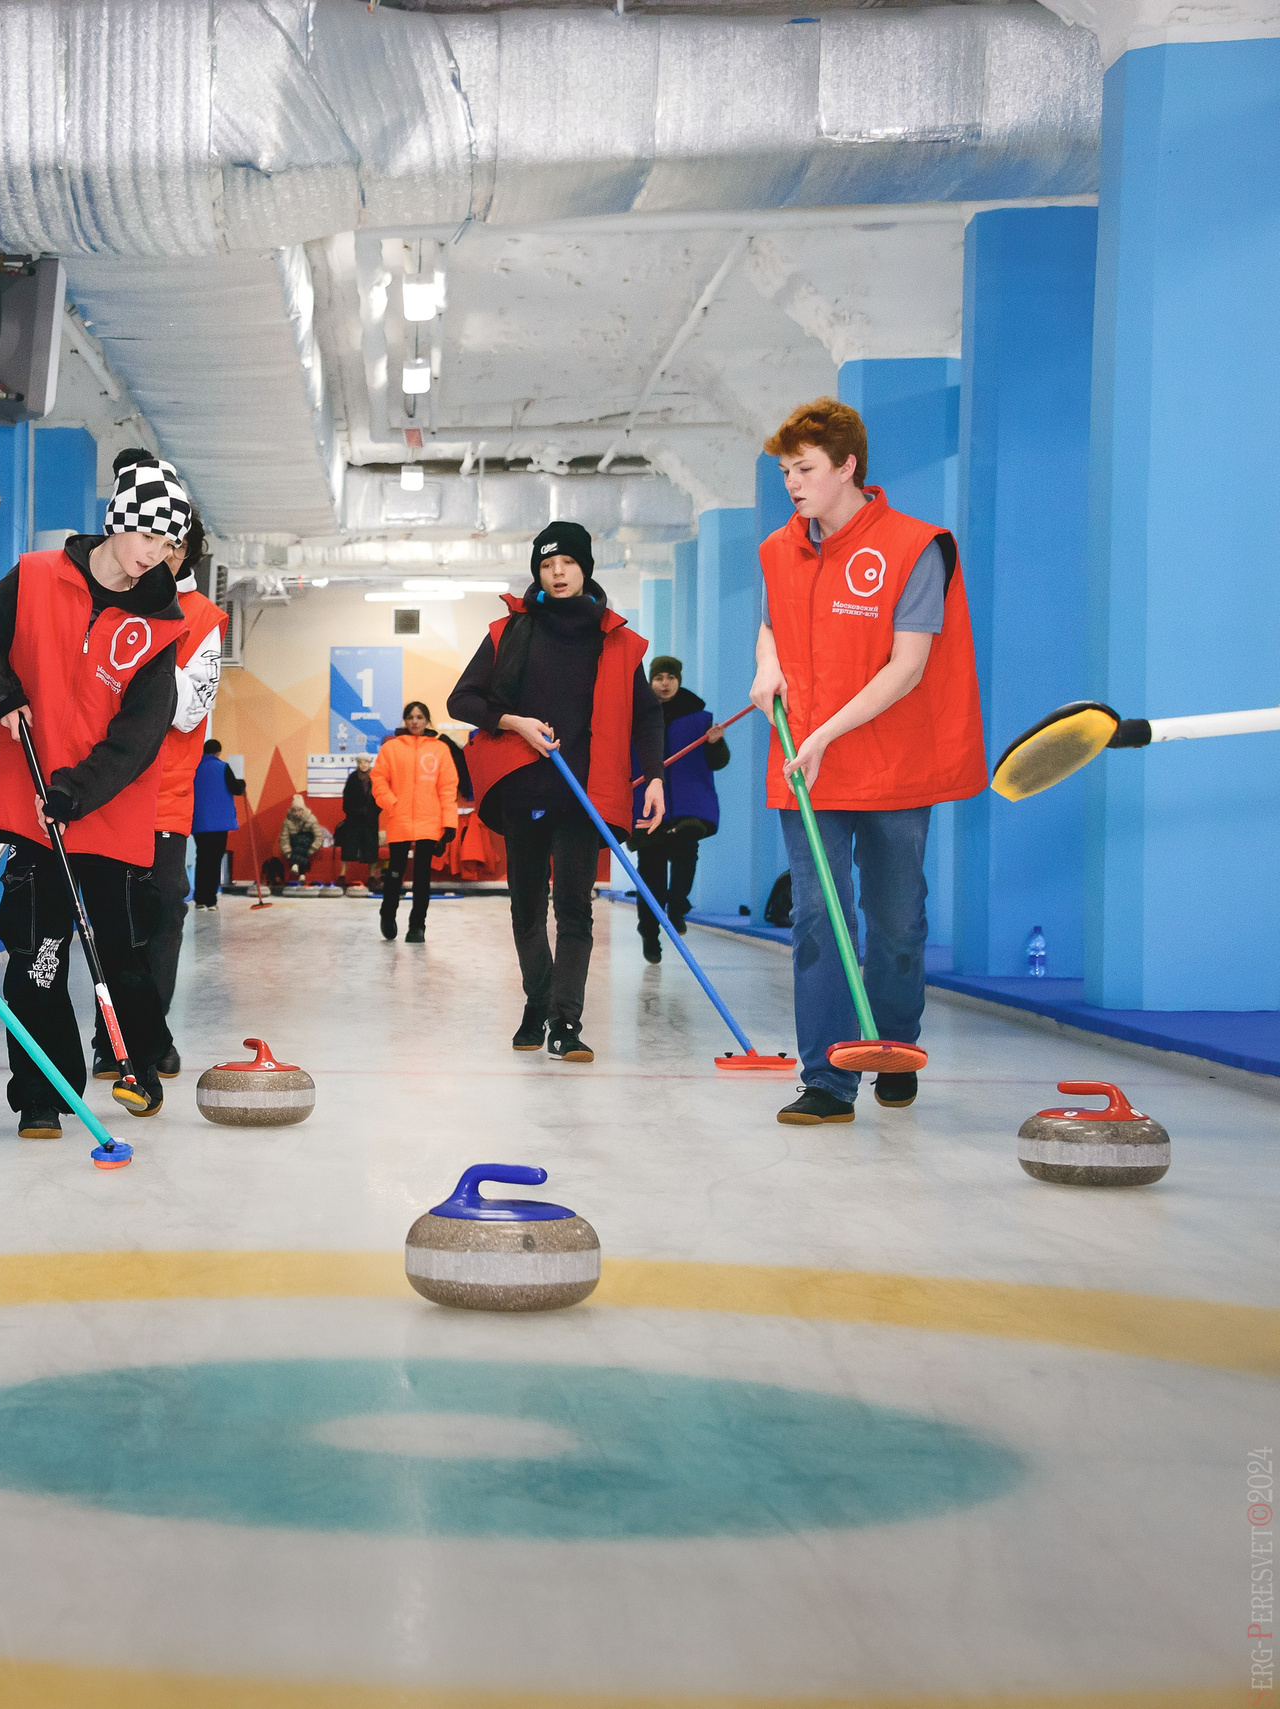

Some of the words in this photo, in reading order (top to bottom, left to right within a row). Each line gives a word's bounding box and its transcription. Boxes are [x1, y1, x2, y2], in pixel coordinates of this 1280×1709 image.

[356, 667, 373, 707] 1
[32, 963, 57, 973] KEEPS
[27, 970, 45, 980] THE
